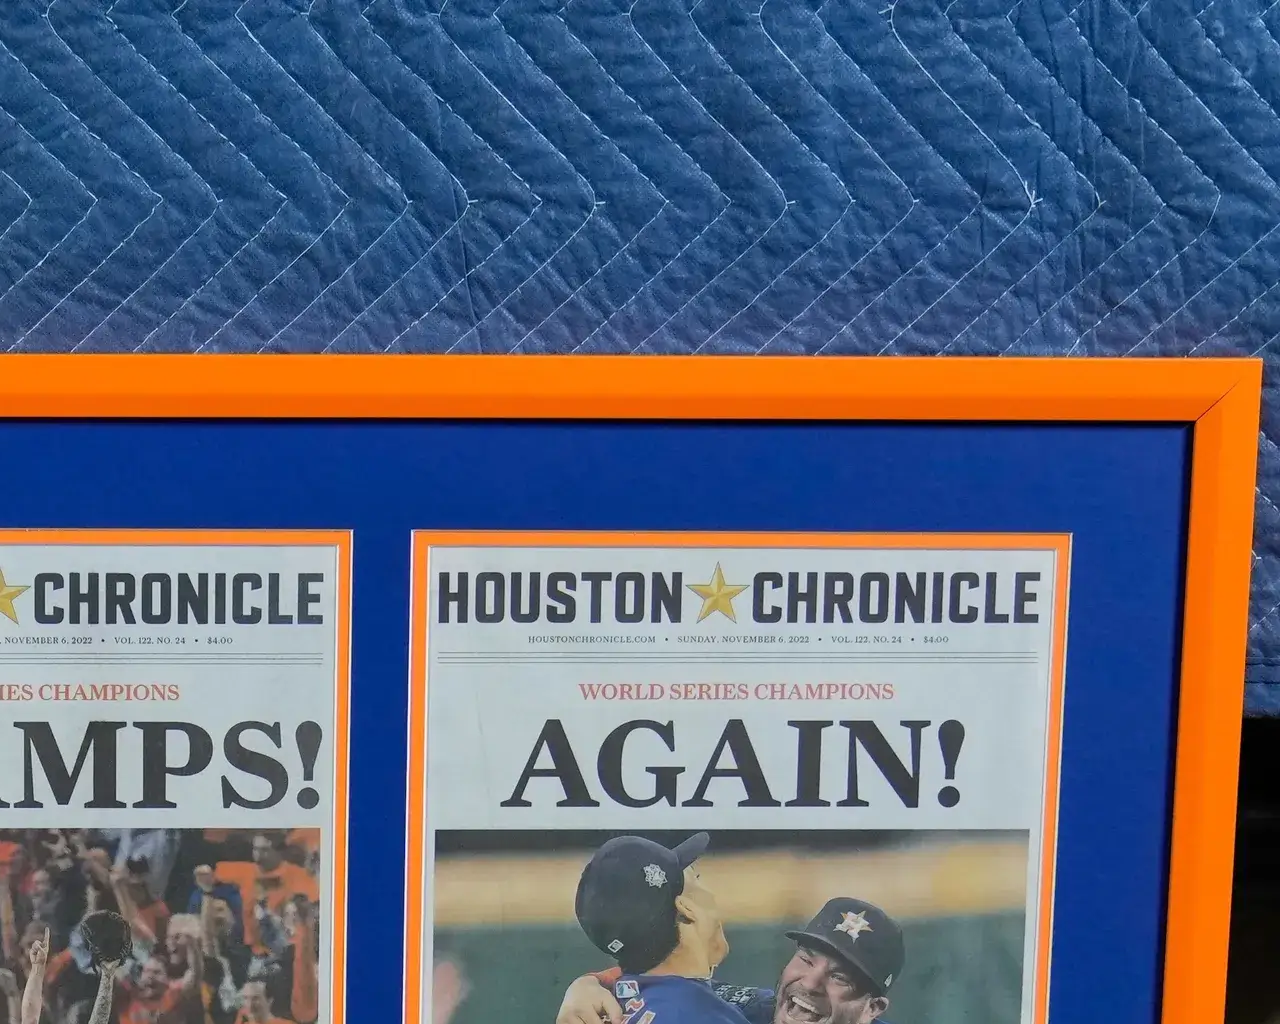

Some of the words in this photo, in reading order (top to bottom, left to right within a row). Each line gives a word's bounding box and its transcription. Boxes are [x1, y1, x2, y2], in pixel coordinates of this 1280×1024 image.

[34, 572, 323, 624] CHRONICLE
[439, 572, 682, 623] HOUSTON
[752, 572, 1040, 623] CHRONICLE
[5, 636, 58, 645] NOVEMBER
[61, 636, 69, 645] 6,
[72, 636, 92, 645] 2022
[114, 636, 136, 645] VOL.
[139, 636, 154, 645] 122,
[157, 636, 172, 645] NO.
[175, 636, 185, 645] 24
[207, 636, 233, 645] $4.00
[529, 635, 655, 644] HOUSTONCHRONICLE.COM
[678, 635, 719, 644] SUNDAY,
[722, 635, 776, 644] NOVEMBER
[778, 635, 786, 644] 6,
[788, 635, 809, 644] 2022
[832, 635, 853, 644] VOL.
[855, 635, 870, 644] 122,
[874, 635, 889, 644] NO.
[892, 635, 901, 644] 24
[924, 635, 949, 644] $4.00
[38, 684, 179, 700] CHAMPIONS
[578, 684, 664, 700] WORLD
[670, 684, 748, 700] SERIES
[754, 684, 893, 700] CHAMPIONS
[500, 719, 965, 808] AGAIN!
